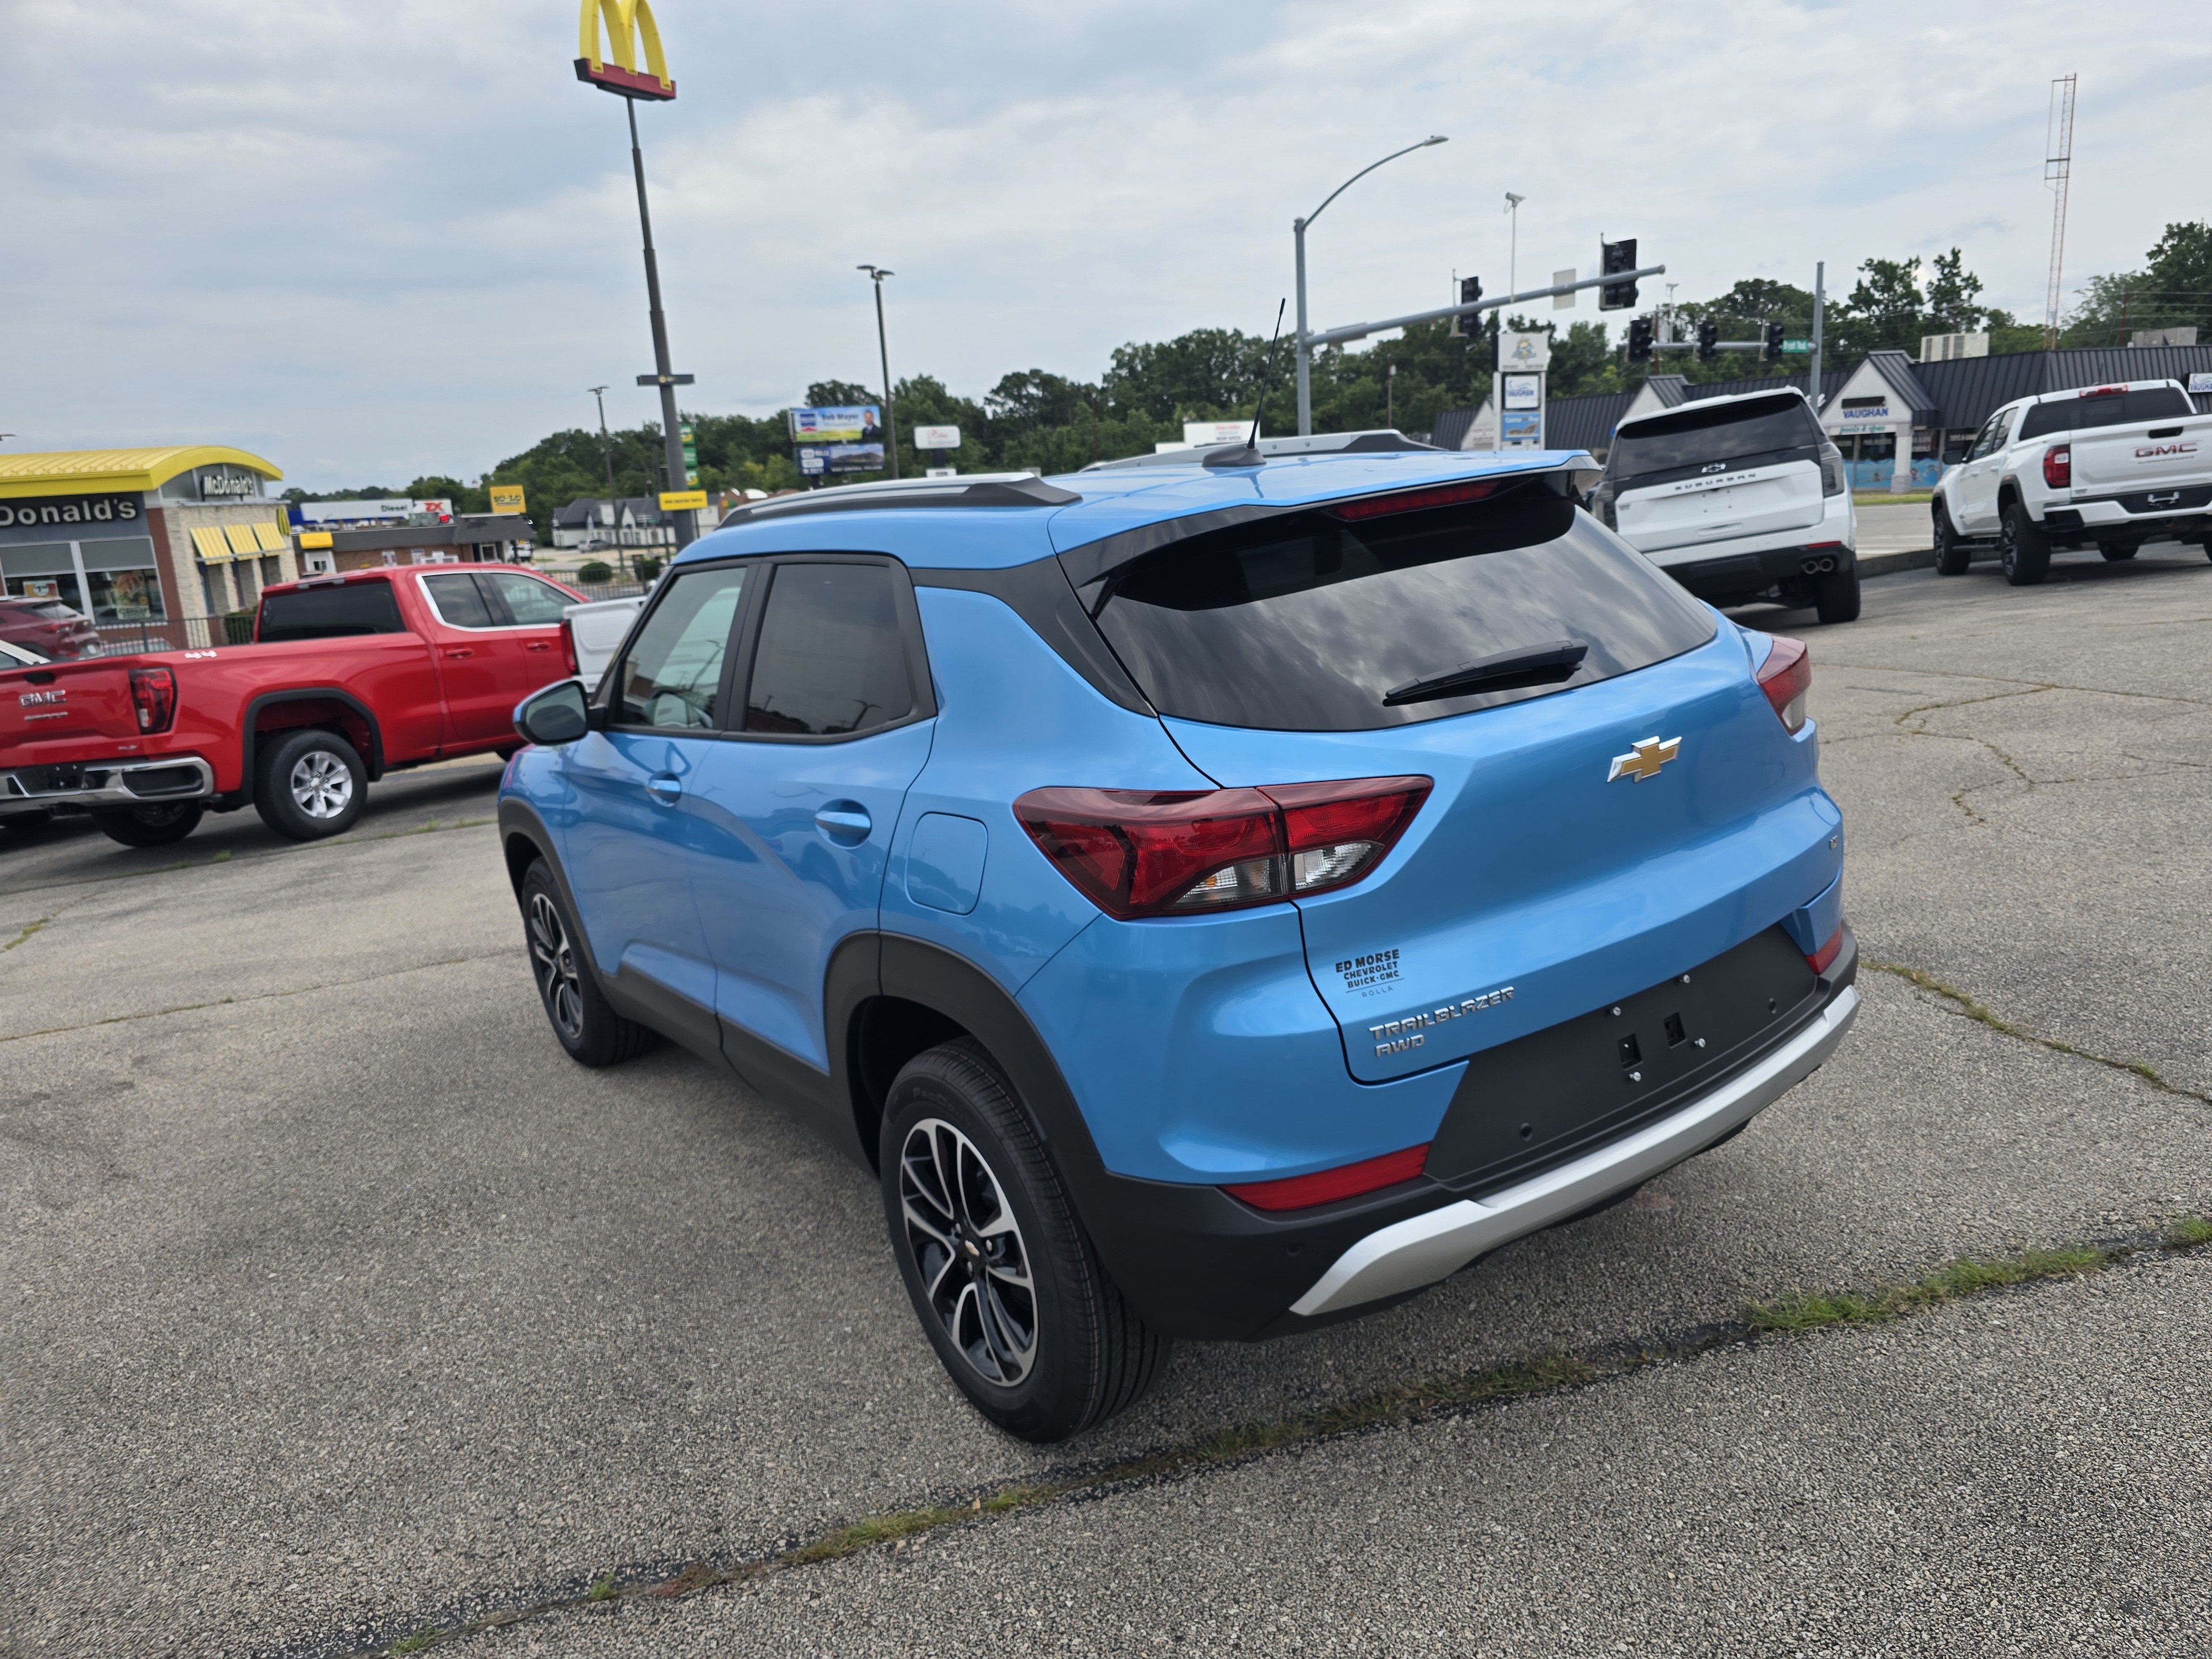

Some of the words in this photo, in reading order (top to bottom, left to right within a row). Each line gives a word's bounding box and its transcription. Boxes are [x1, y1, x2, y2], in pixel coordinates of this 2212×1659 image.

[1843, 408, 1888, 419] VAUGHAN
[2135, 442, 2198, 458] GMC
[204, 474, 254, 495] McDonald's
[1674, 473, 1756, 491] SUBURBAN
[19, 689, 67, 707] GMC
[1335, 959, 1353, 973] ED
[1355, 949, 1400, 968] MORSE
[1344, 961, 1398, 980] CHEVROLET
[1361, 985, 1393, 998] ROLLA
[1369, 986, 1515, 1040] TRAILBLAZER
[1375, 1034, 1425, 1057] AWD
